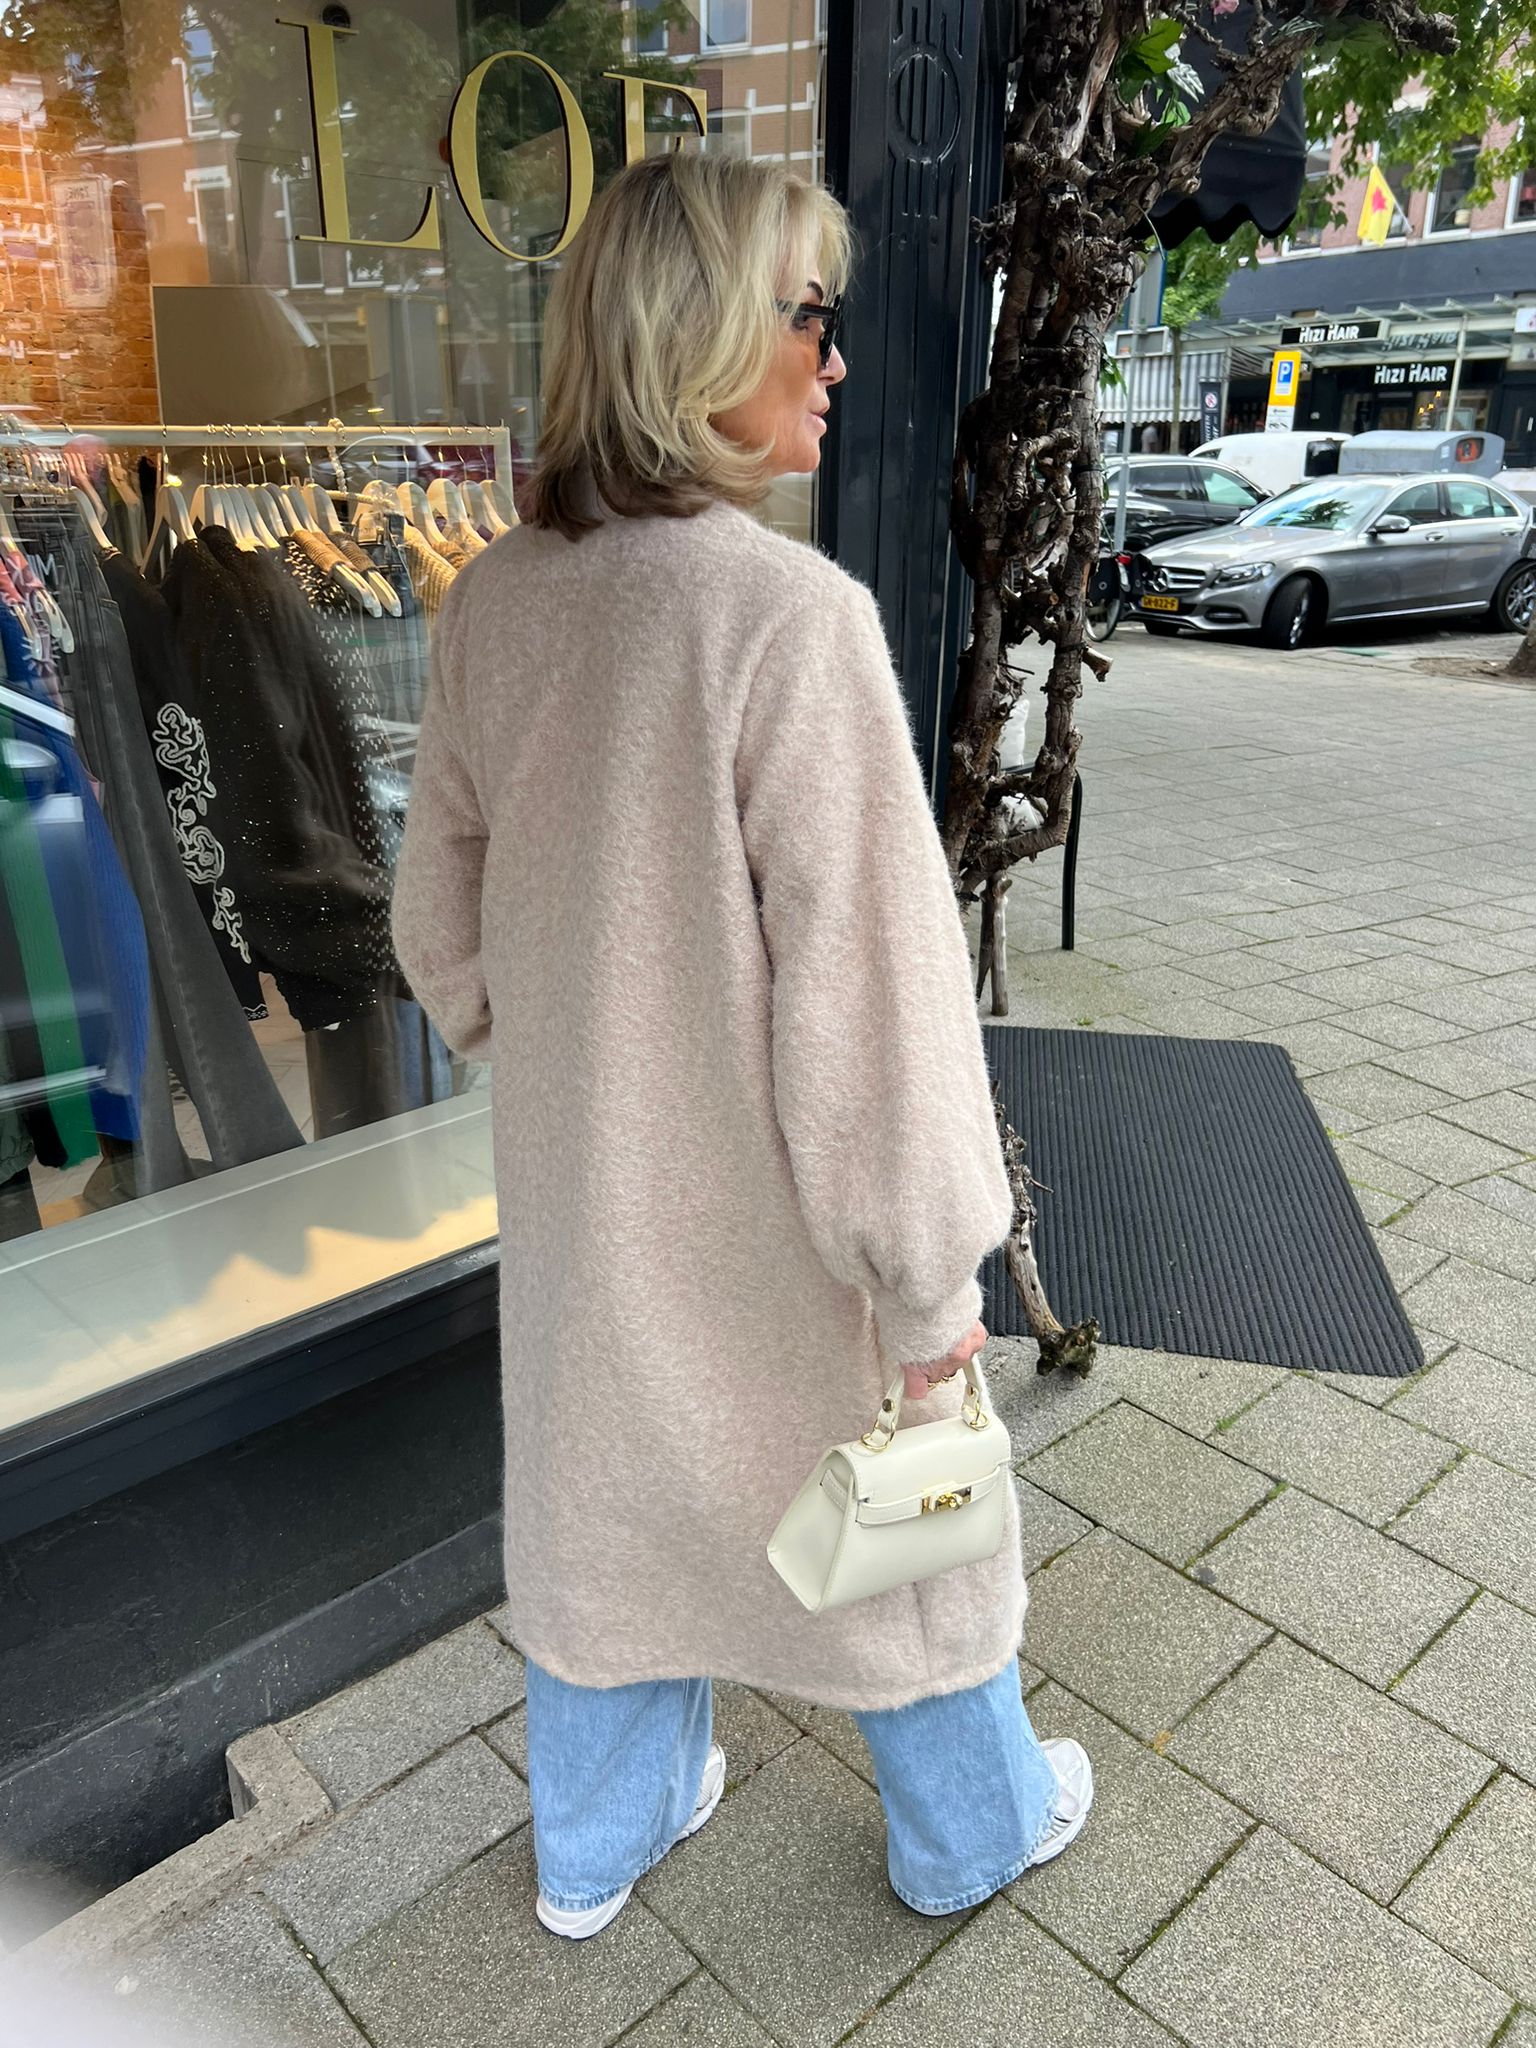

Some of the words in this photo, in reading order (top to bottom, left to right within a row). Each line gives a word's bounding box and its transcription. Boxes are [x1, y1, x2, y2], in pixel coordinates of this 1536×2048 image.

[1299, 326, 1325, 343] HIZI
[1327, 324, 1360, 341] HAIR
[1279, 361, 1291, 383] P
[1374, 364, 1406, 385] HIZI
[1408, 363, 1448, 383] HAIR
